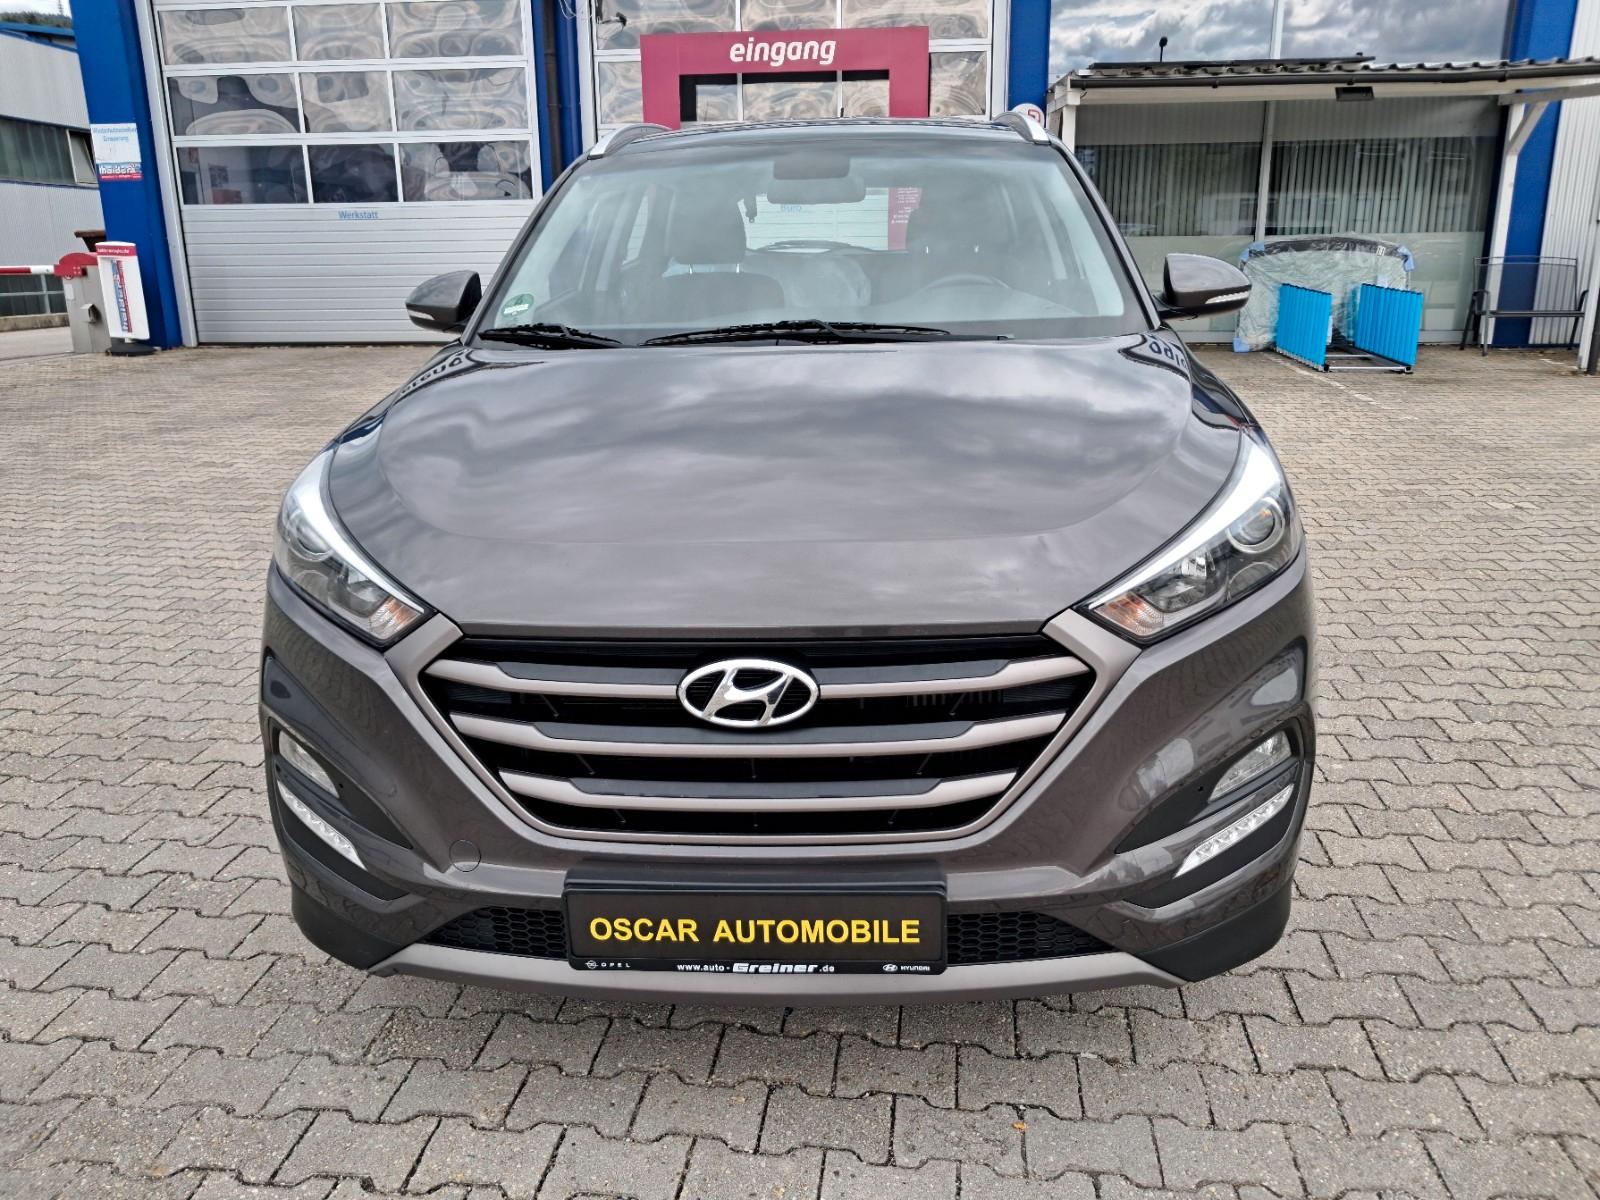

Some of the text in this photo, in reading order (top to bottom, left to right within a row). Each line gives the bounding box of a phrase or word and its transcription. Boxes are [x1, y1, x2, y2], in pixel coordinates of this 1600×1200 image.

[729, 36, 837, 67] eingang
[338, 209, 379, 219] Werkstatt
[589, 917, 921, 944] OSCAR AUTOMOBILE
